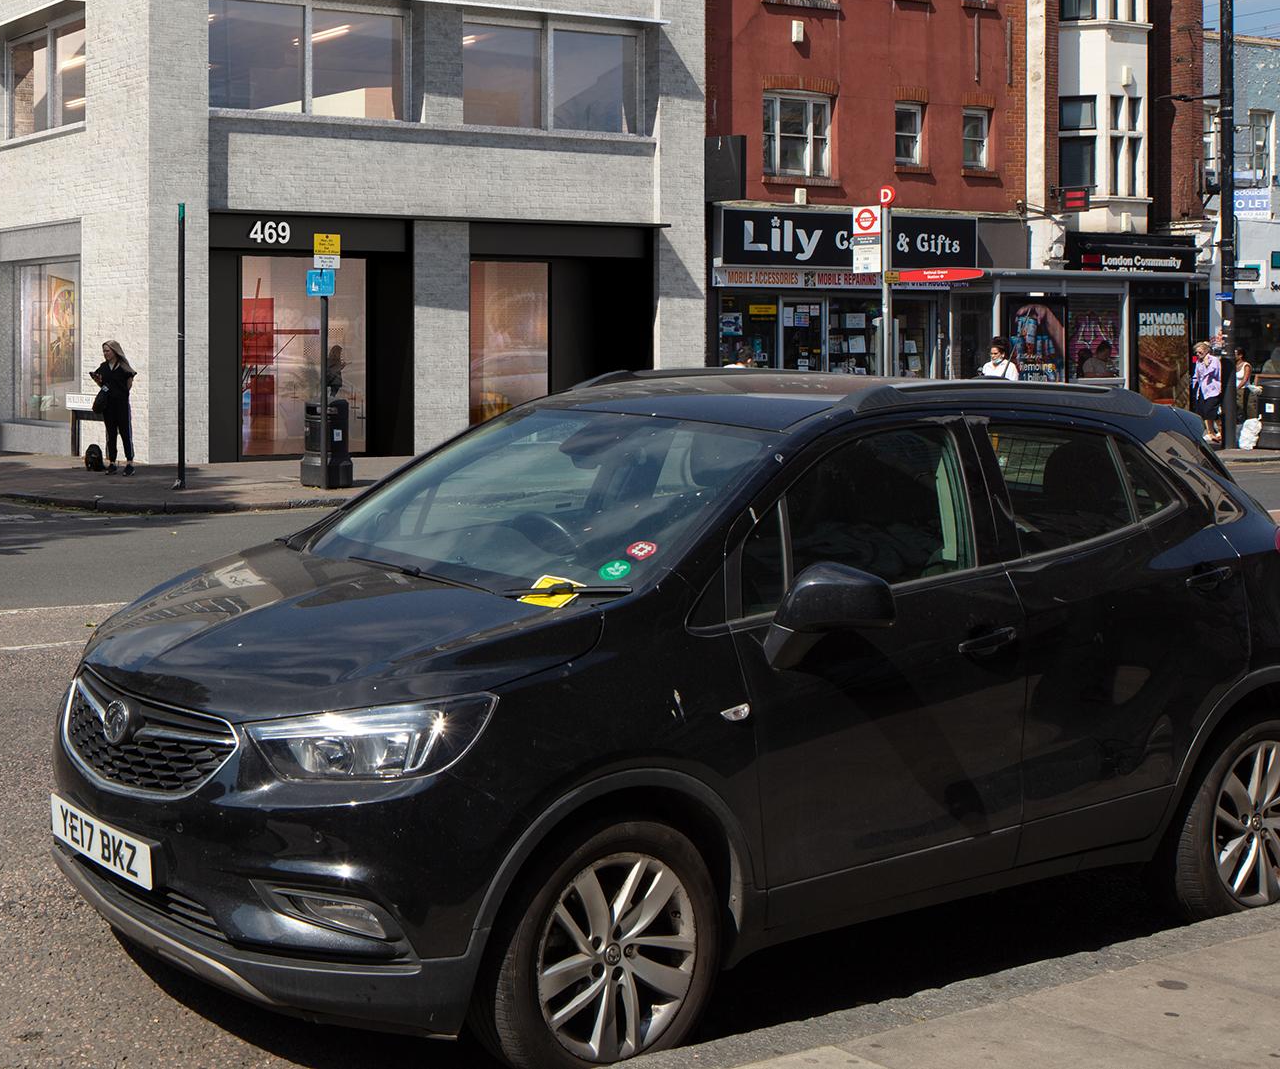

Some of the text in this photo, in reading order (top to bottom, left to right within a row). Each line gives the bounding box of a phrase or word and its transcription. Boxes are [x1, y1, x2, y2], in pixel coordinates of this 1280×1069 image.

[880, 189, 892, 202] D
[1249, 199, 1269, 208] LET
[249, 220, 291, 244] 469
[743, 216, 823, 261] Lily
[896, 233, 960, 255] & Gifts
[1101, 254, 1182, 269] London Community
[727, 272, 799, 285] MOBILE ACCESSORIES
[817, 273, 842, 286] MOBILE
[843, 273, 877, 286] REPAIRING
[1138, 312, 1185, 325] PHWOAR
[1138, 324, 1185, 336] BURTONS
[60, 805, 138, 877] YE17 BKZ
